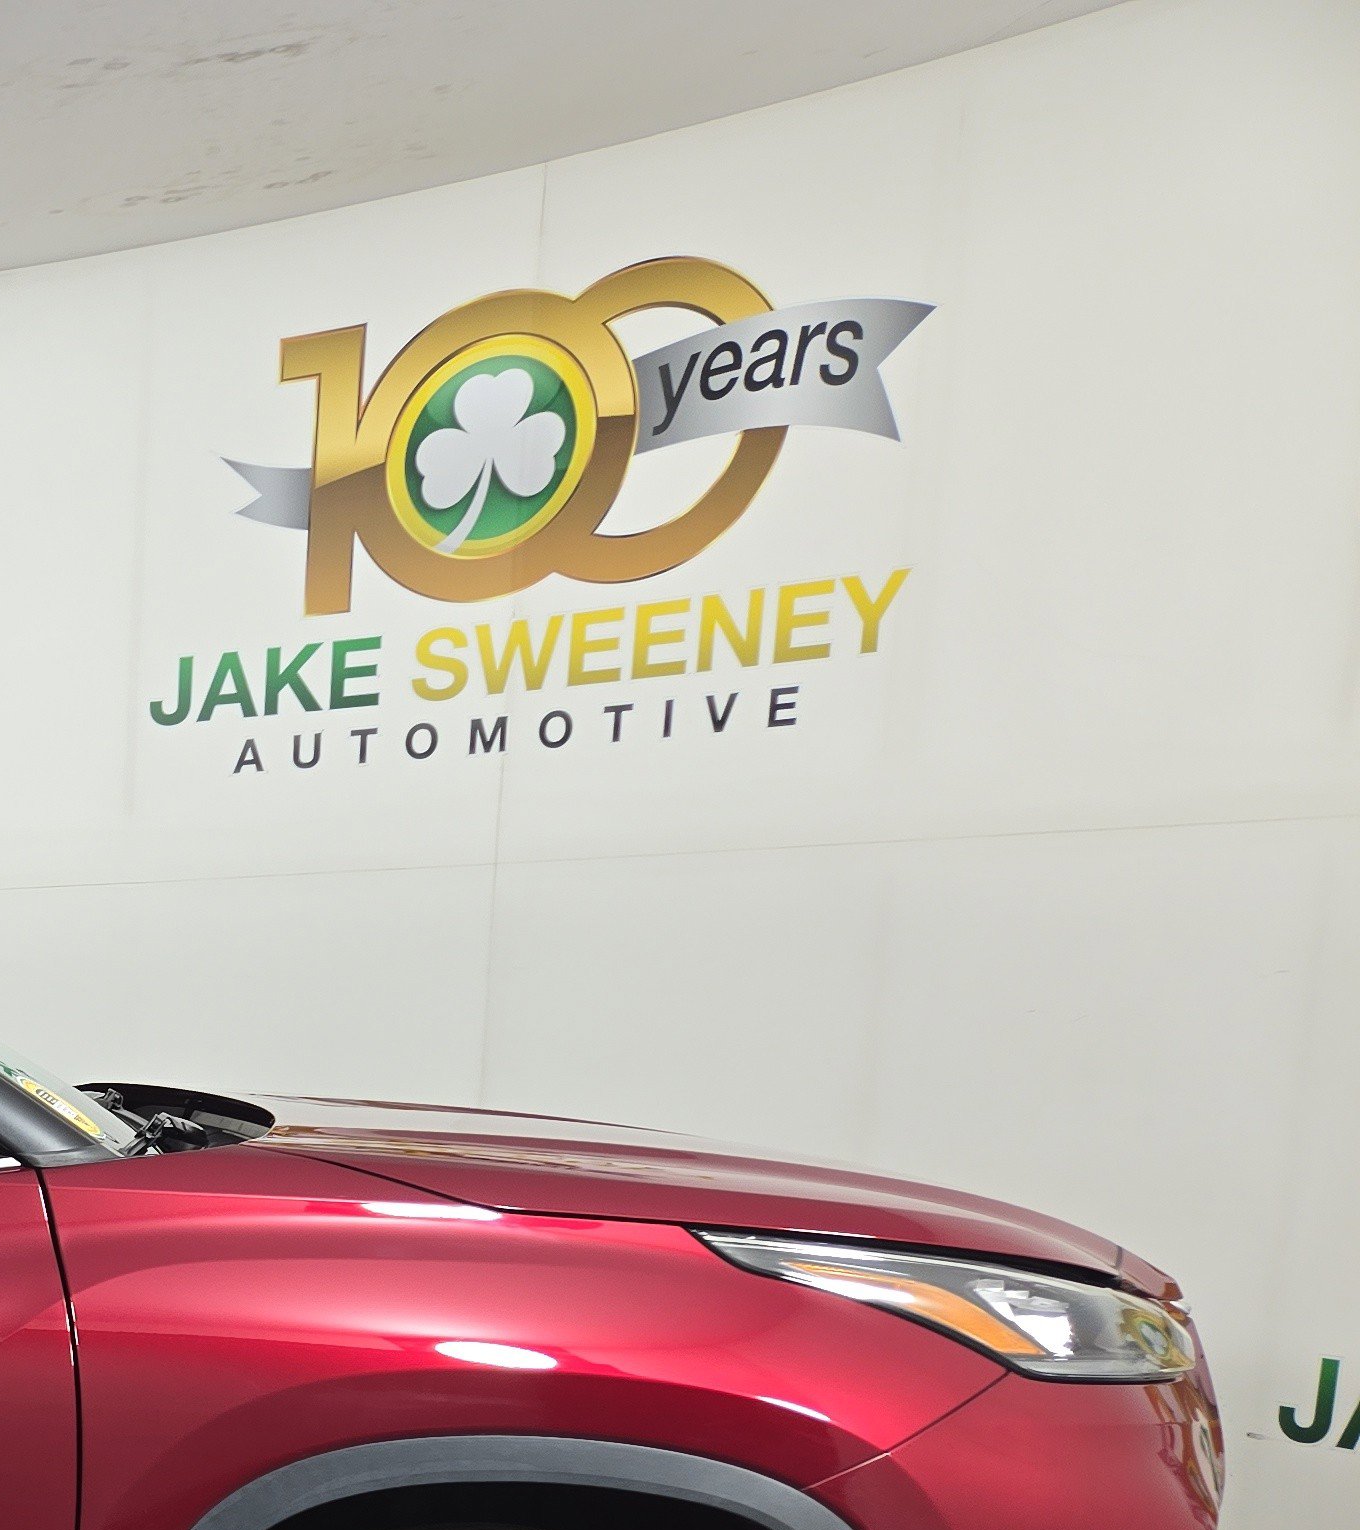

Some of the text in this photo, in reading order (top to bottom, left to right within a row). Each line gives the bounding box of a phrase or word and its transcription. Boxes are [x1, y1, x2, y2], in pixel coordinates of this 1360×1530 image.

[280, 255, 863, 616] 100 years
[149, 568, 911, 726] JAKE SWEENEY
[233, 686, 800, 774] AUTOMOTIVE
[1279, 1358, 1360, 1449] J
